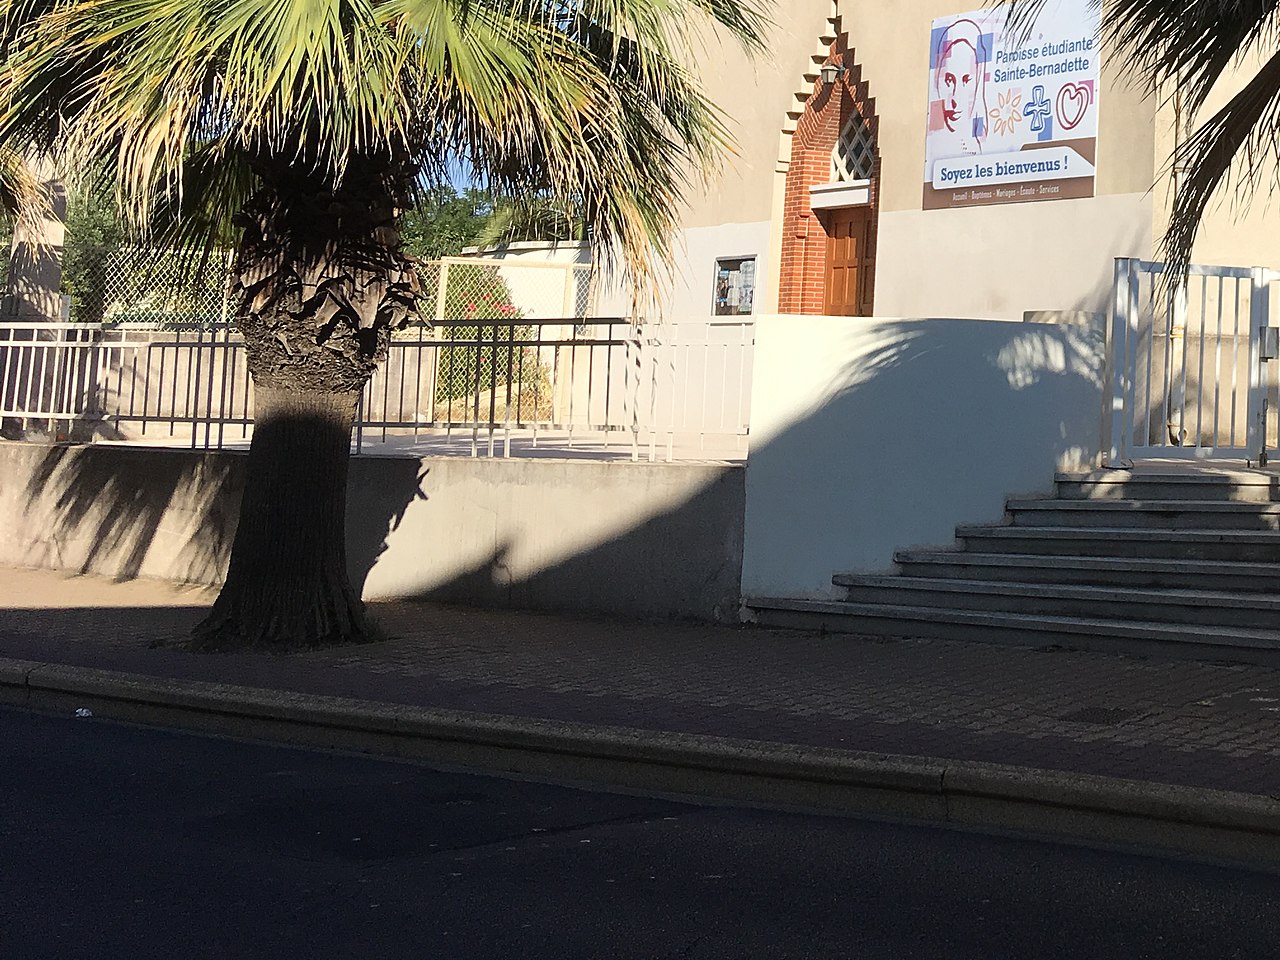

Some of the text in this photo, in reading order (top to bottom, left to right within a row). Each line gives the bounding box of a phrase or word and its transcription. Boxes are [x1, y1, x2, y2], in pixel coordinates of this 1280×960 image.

[995, 36, 1093, 65] Paroisse étudiante
[994, 57, 1090, 83] Sainte-Bernadette
[940, 155, 1068, 184] Soyez les bienvenus !
